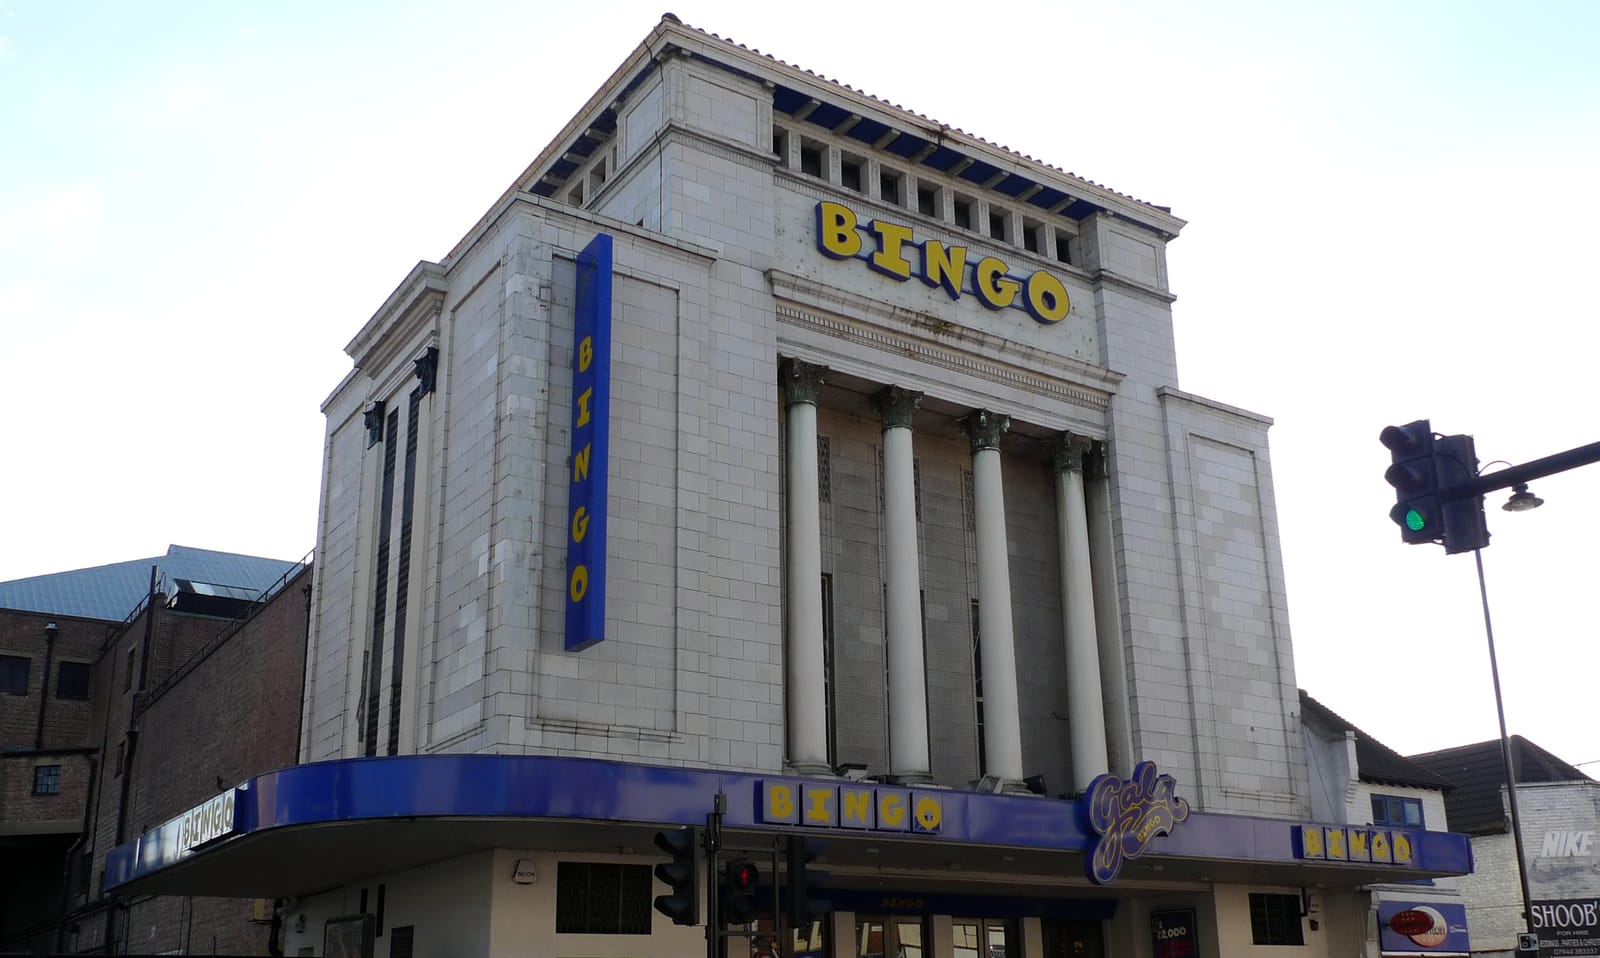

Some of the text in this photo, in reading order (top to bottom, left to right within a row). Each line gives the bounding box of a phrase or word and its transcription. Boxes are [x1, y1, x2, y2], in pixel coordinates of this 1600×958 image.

[815, 201, 1071, 325] BINGO
[570, 335, 594, 603] BINGO
[183, 796, 234, 847] BINGO
[769, 784, 942, 830] BINGO
[1136, 815, 1161, 843] BINGO
[1304, 828, 1411, 861] BINGO
[1540, 831, 1595, 857] NIKE
